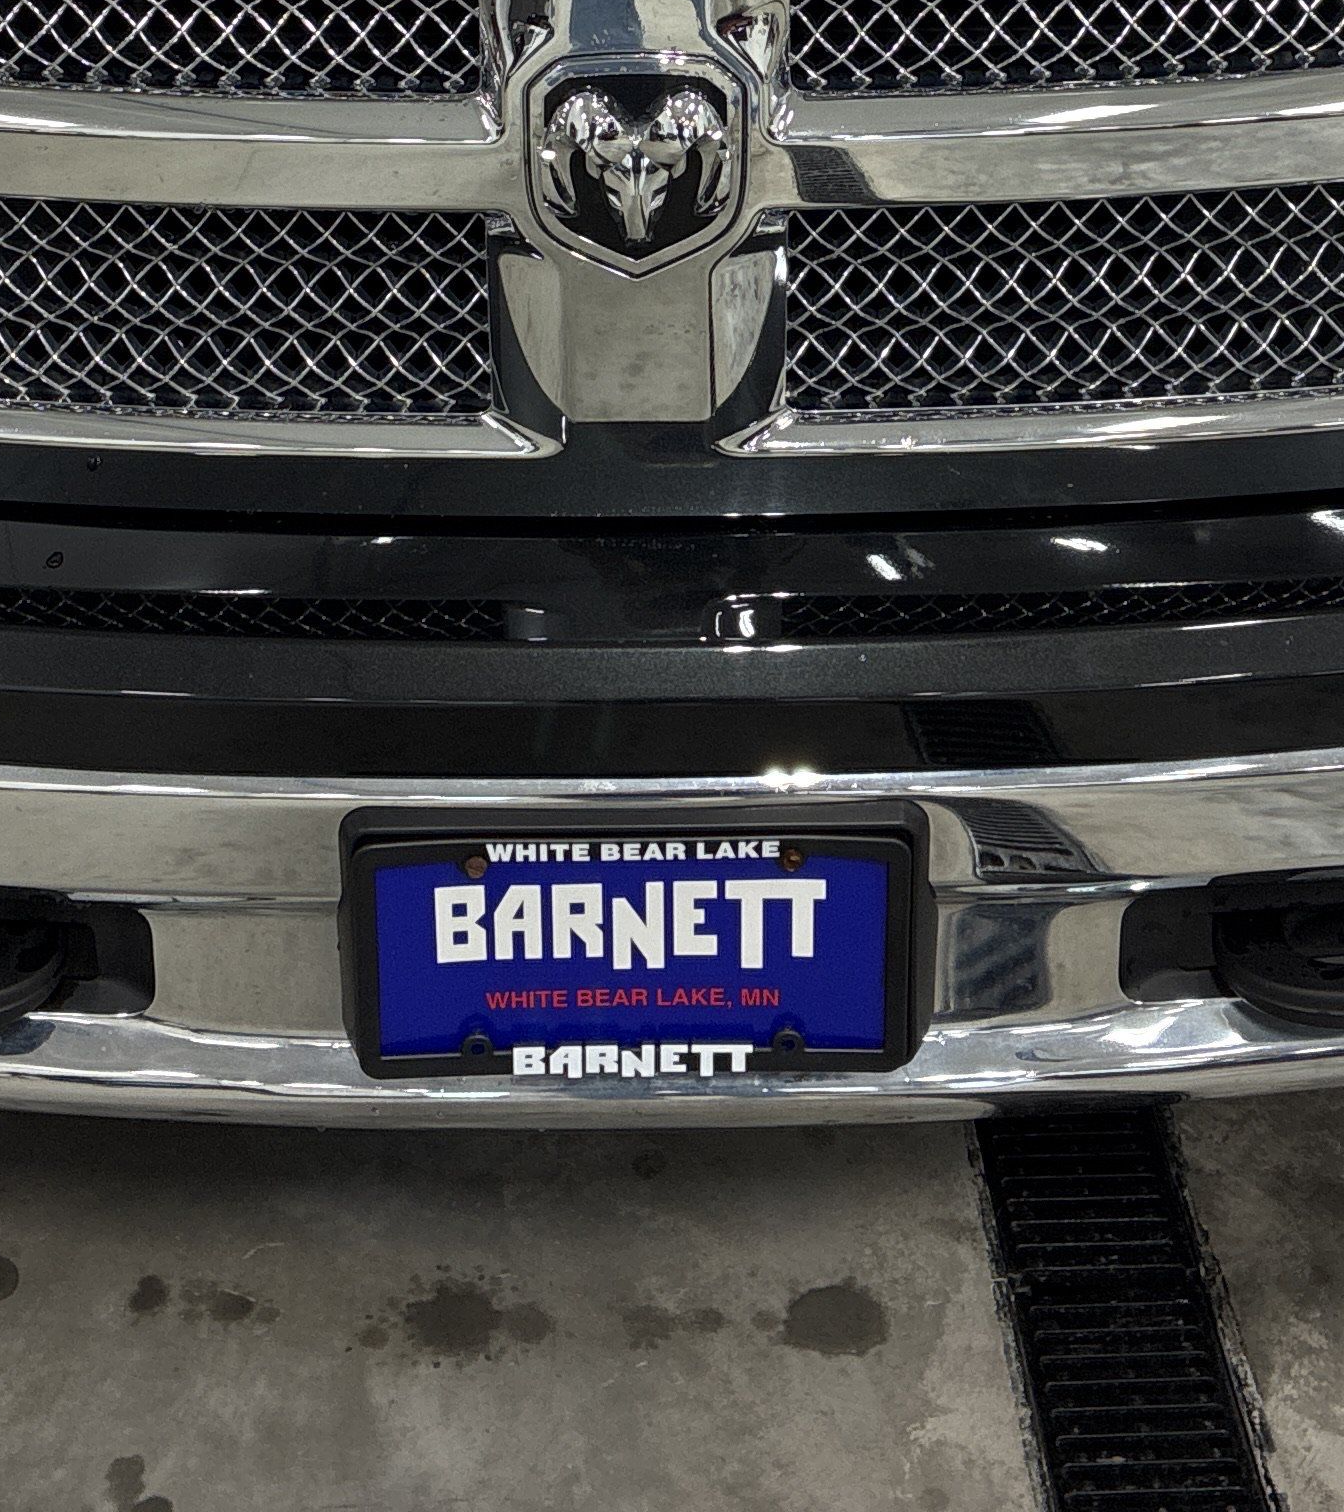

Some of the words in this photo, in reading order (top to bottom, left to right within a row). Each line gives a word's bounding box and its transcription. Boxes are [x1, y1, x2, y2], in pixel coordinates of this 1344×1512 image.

[485, 843, 591, 863] WHITE
[600, 842, 687, 861] BEAR
[696, 840, 781, 860] LAKE
[434, 878, 827, 970] BARNETT
[485, 990, 569, 1010] WHITE
[576, 988, 648, 1007] BEAR
[657, 988, 733, 1008] LAKE,
[741, 988, 780, 1007] MN
[513, 1044, 754, 1079] BARNETT
